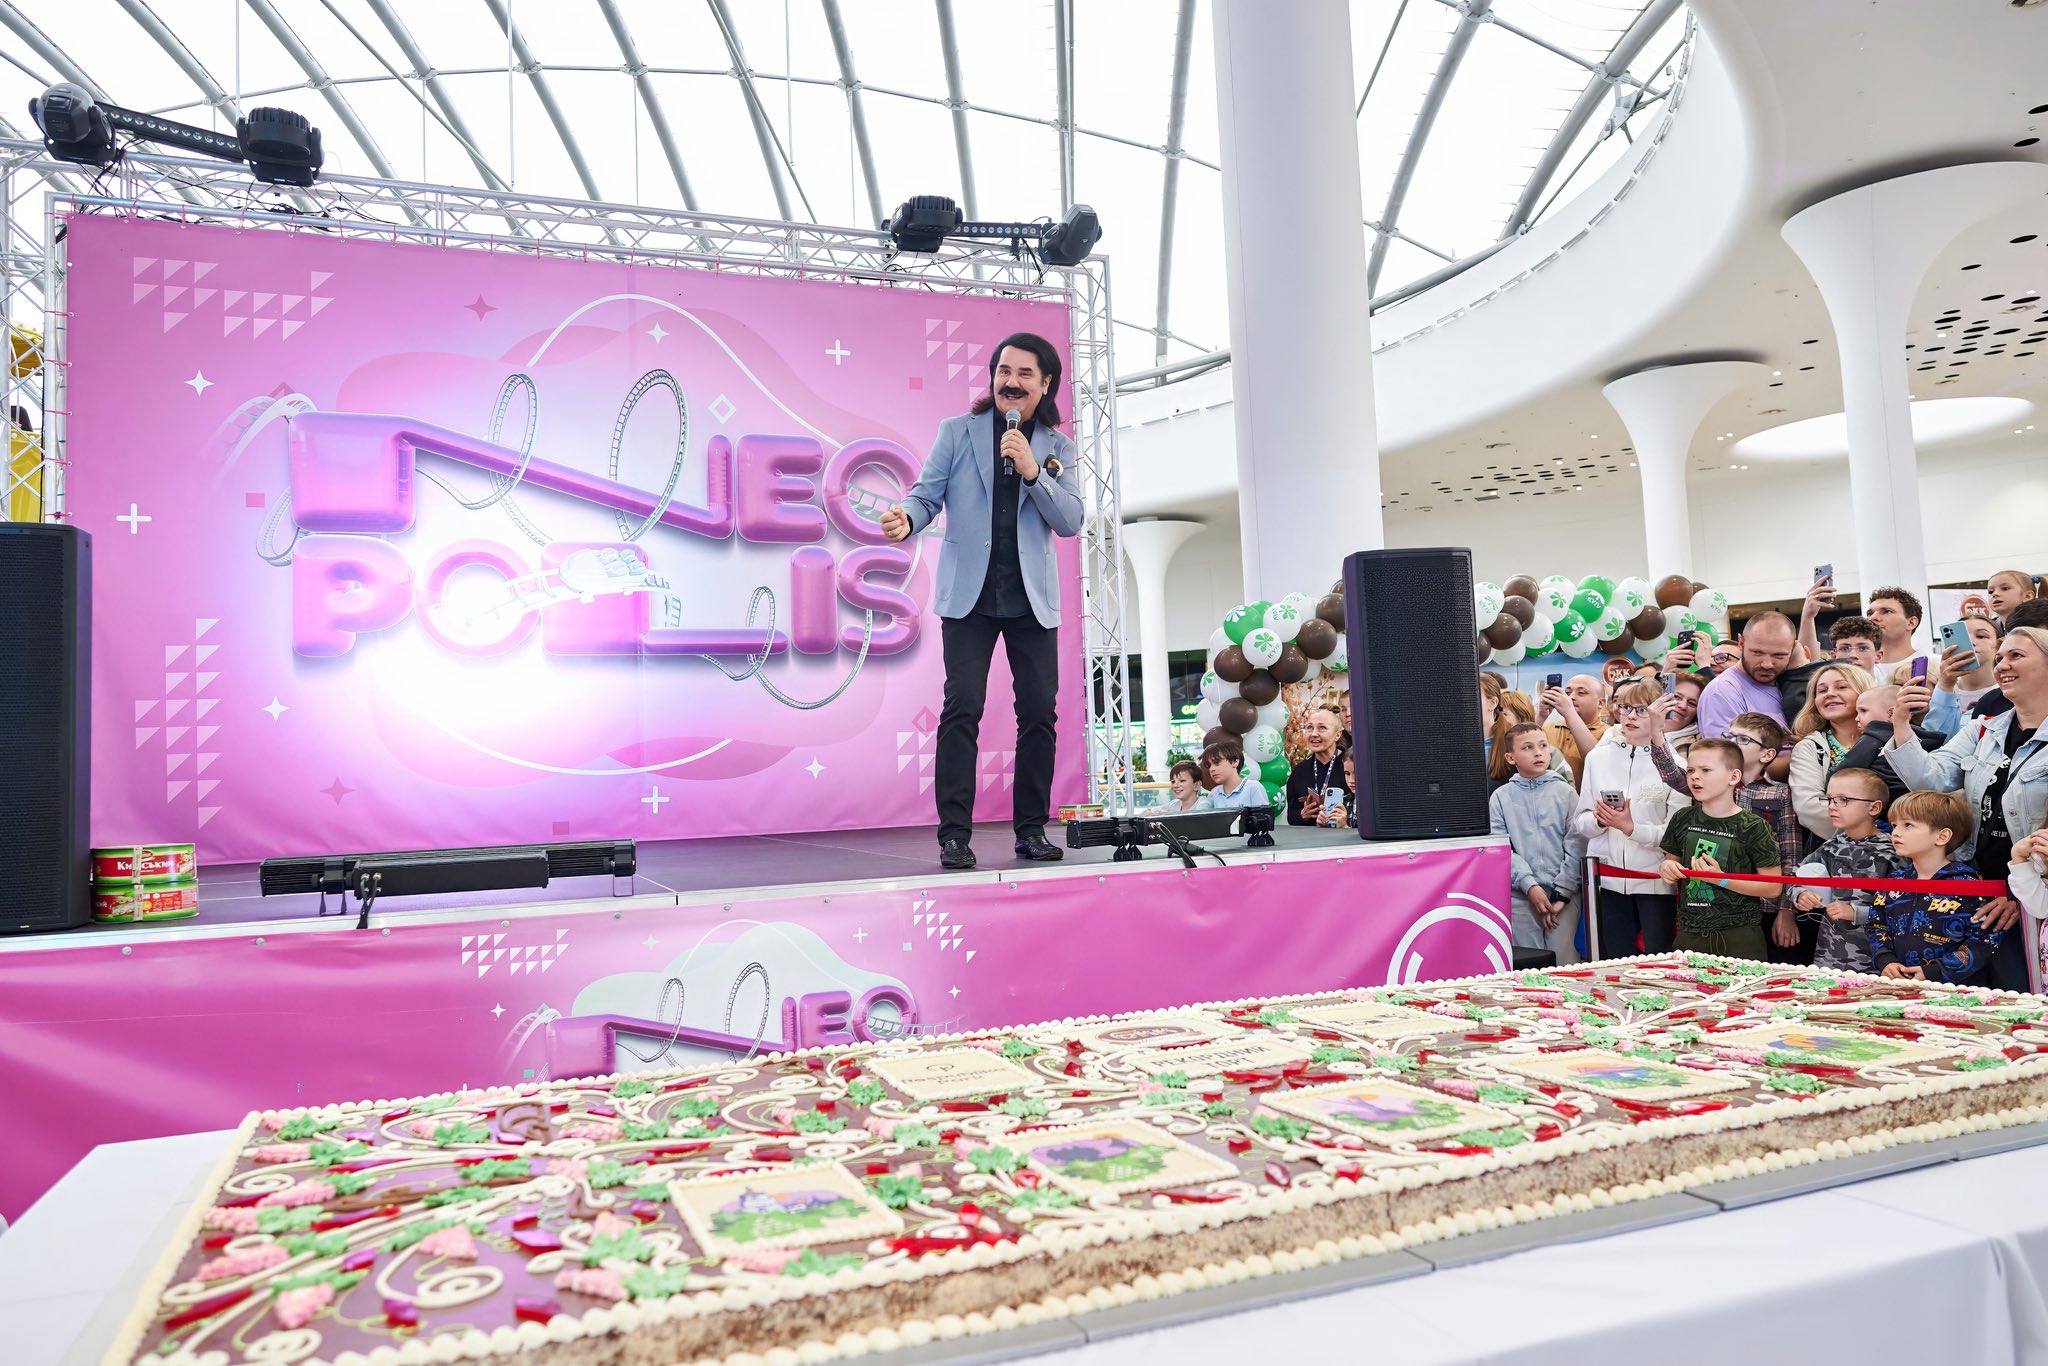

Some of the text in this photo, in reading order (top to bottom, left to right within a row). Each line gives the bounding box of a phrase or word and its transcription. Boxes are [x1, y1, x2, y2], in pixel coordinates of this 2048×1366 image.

[290, 411, 925, 546] NEO
[291, 534, 923, 657] POLIS
[117, 860, 175, 870] Киський
